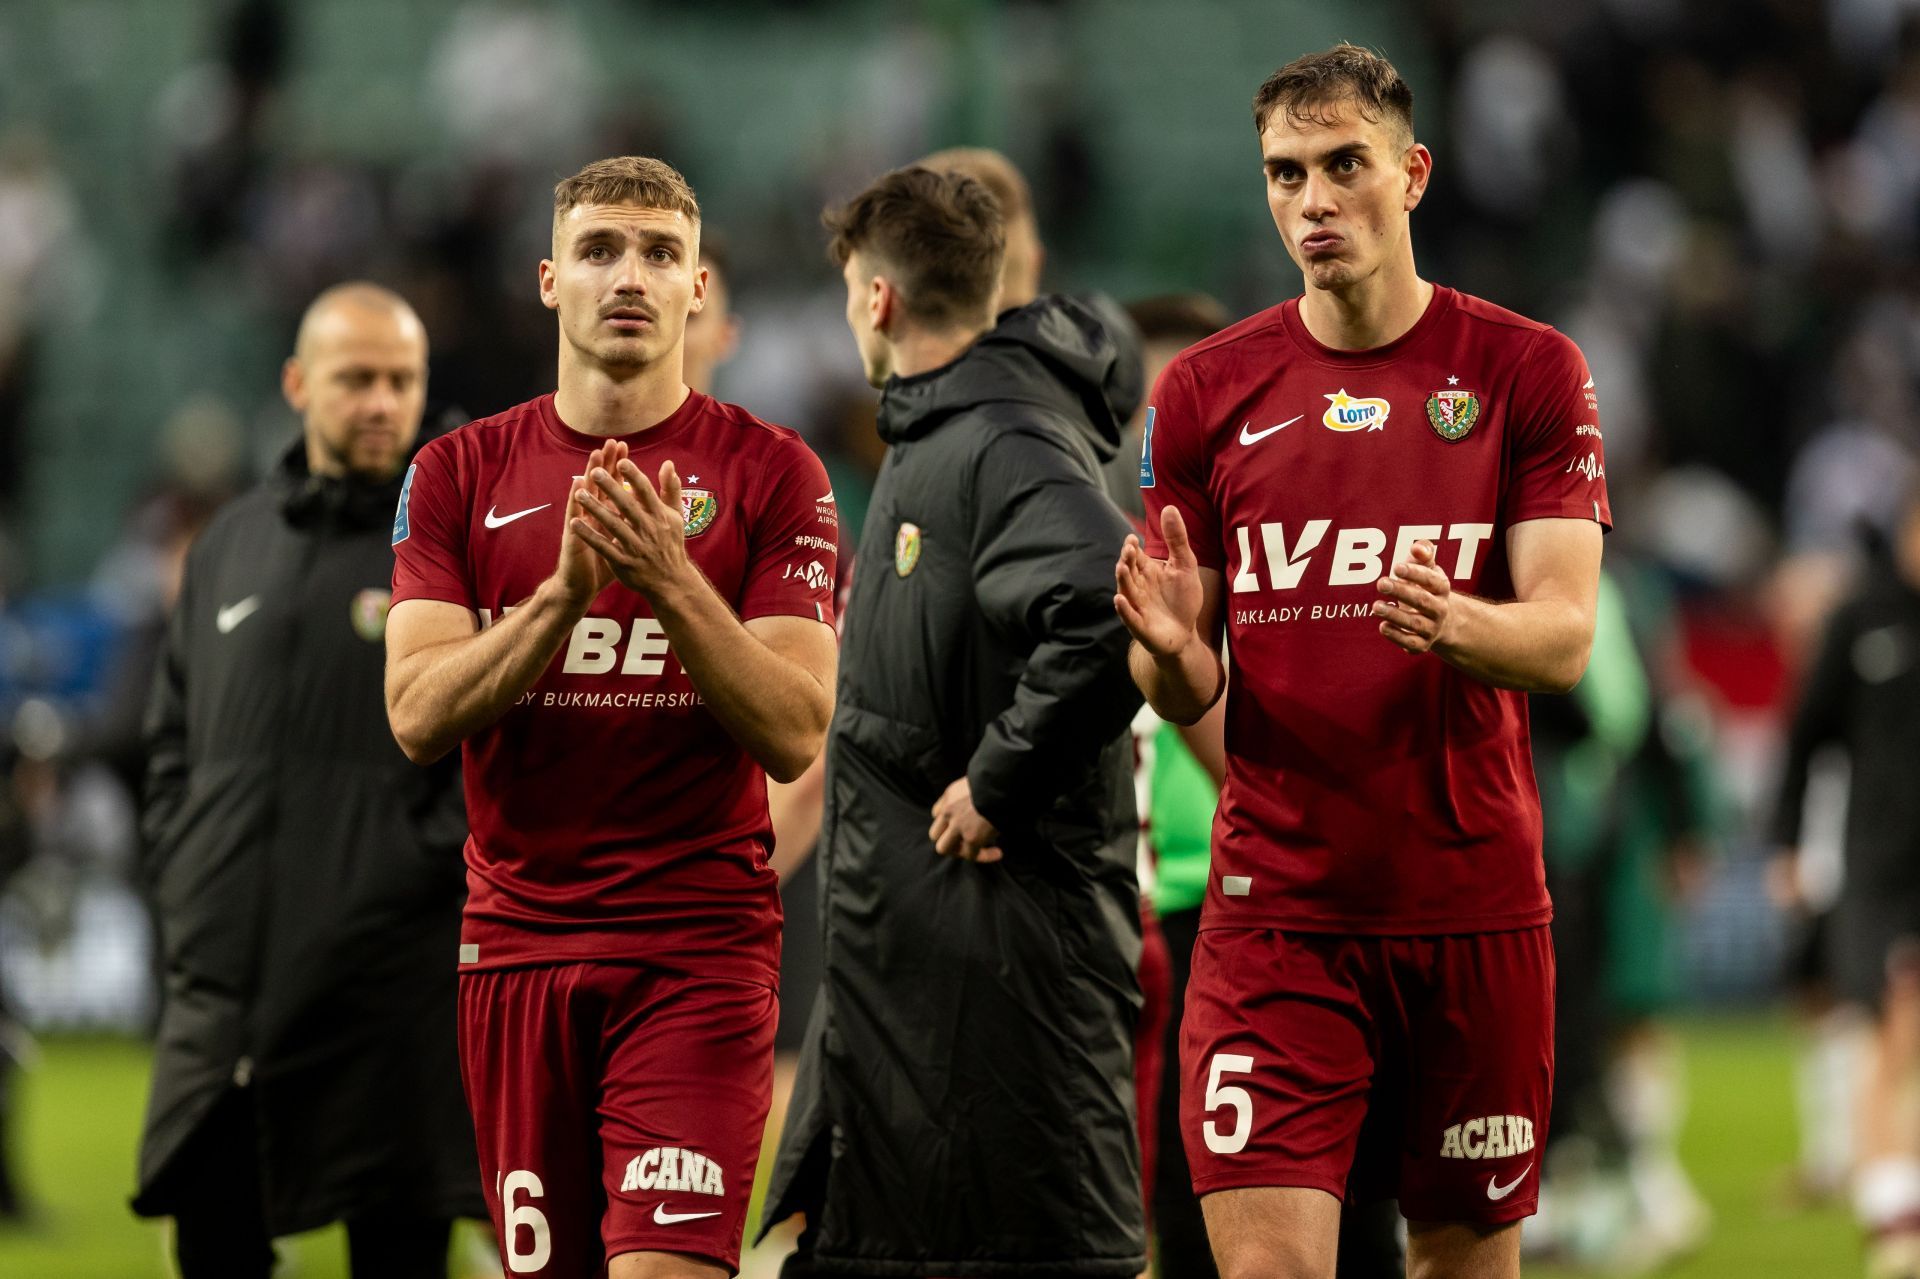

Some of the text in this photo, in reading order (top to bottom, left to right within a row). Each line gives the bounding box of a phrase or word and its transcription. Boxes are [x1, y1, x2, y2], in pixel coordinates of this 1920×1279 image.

[1338, 405, 1376, 423] LOTTO
[1237, 606, 1303, 625] ZAKŁADY
[1203, 1043, 1254, 1154] 5
[1440, 1115, 1536, 1160] ACANA
[621, 1146, 725, 1197] ACANA
